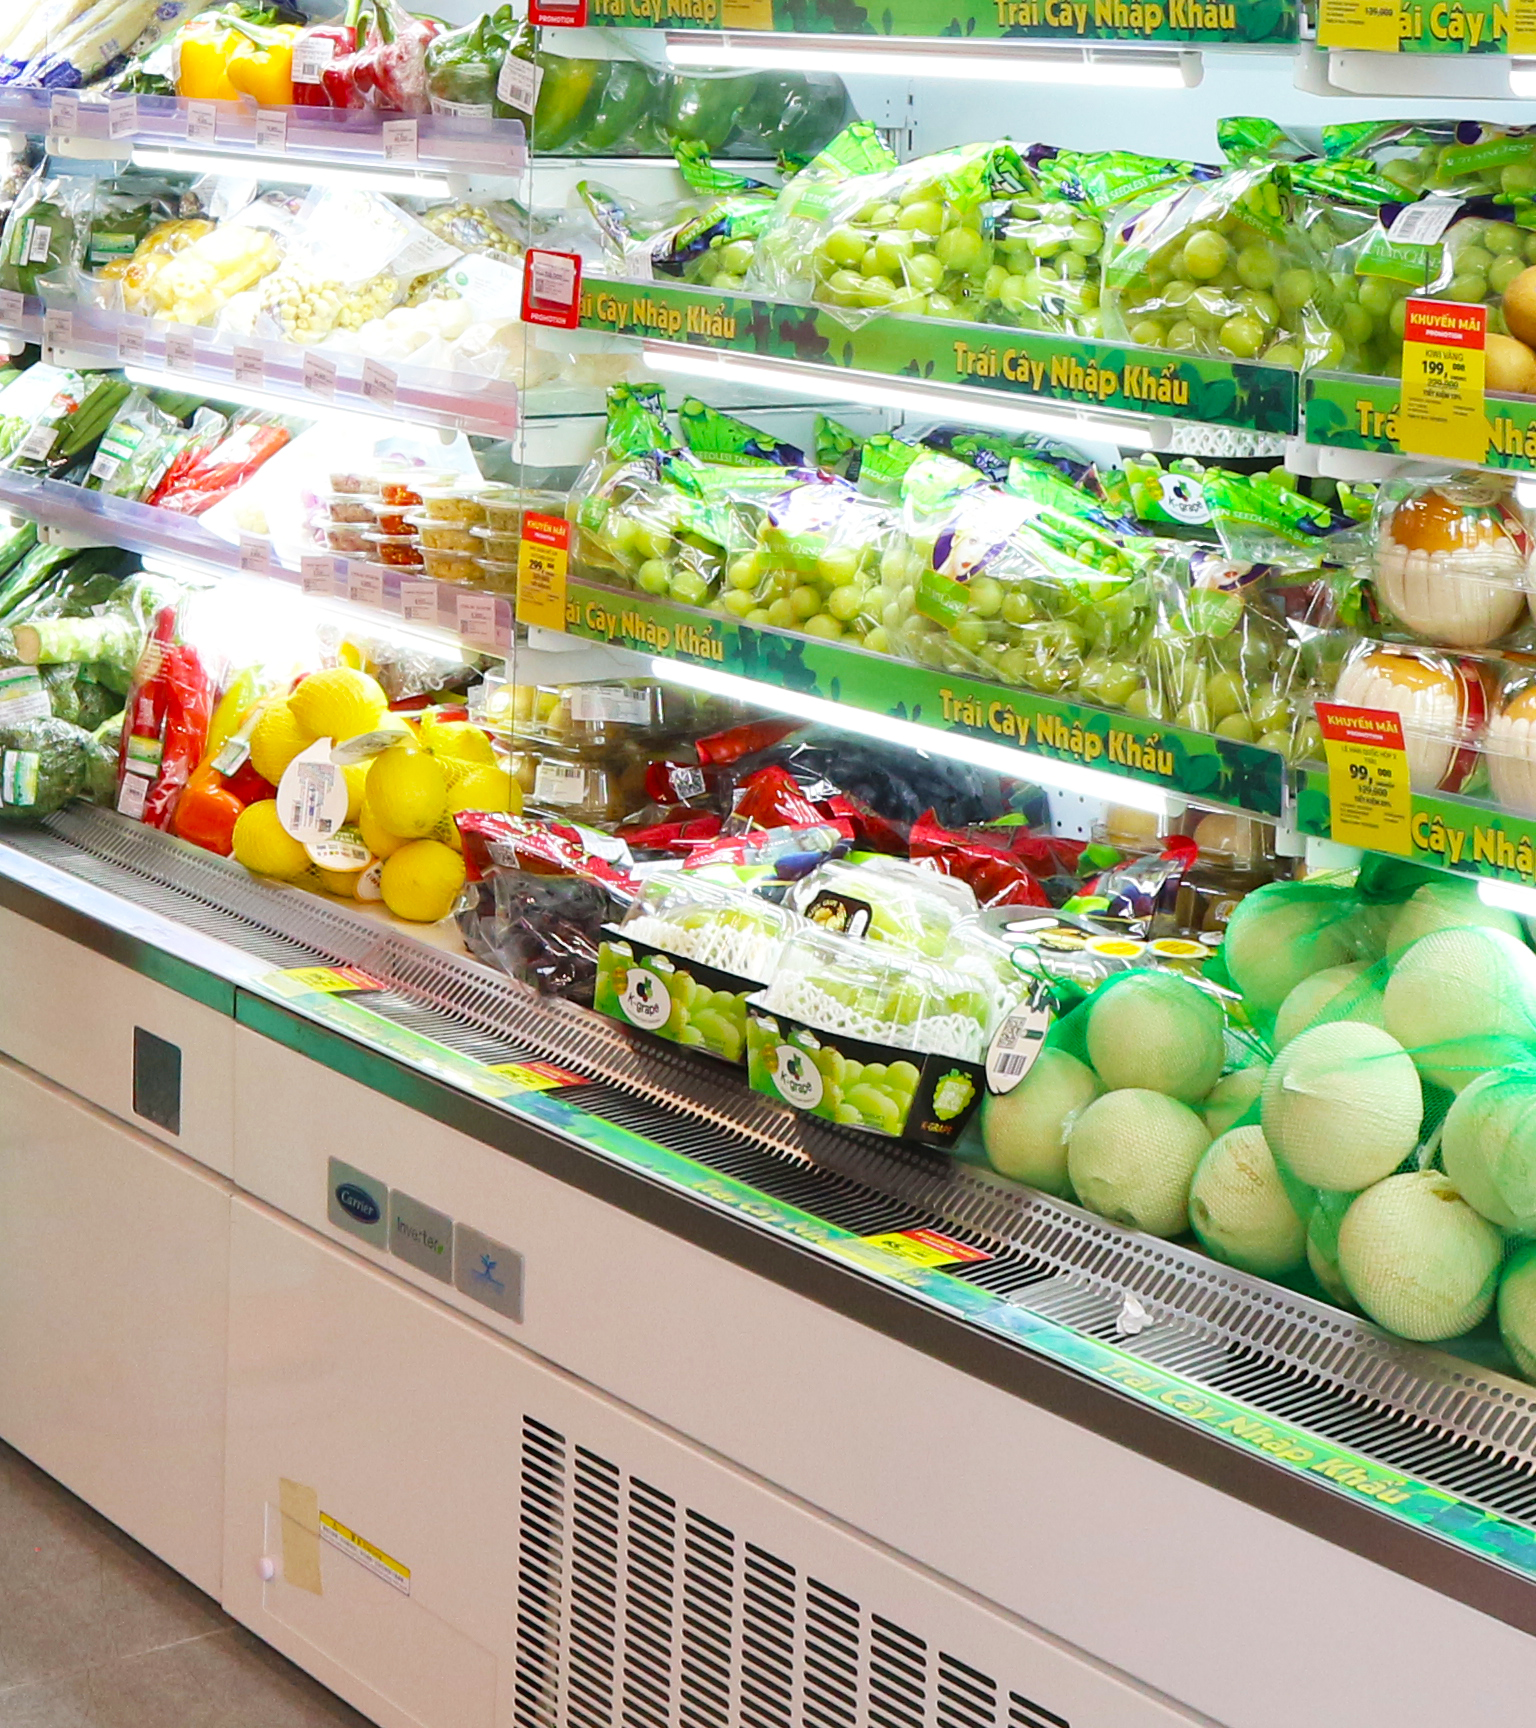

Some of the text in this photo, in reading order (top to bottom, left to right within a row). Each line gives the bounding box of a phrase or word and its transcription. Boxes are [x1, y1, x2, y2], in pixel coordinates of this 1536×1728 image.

[1410, 313, 1481, 332] KHUYẾN MÃI
[953, 342, 1189, 406] Trái Cây Nhập Khẩu
[585, 602, 724, 663] Cây Nhập Khẩu
[939, 689, 1174, 777] Trái Cây Nhập Khẩu
[1327, 715, 1398, 733] KHUYẾN MÃI
[1411, 811, 1466, 864] Cây
[340, 1191, 374, 1216] Carrier
[397, 1216, 439, 1251] Inverter
